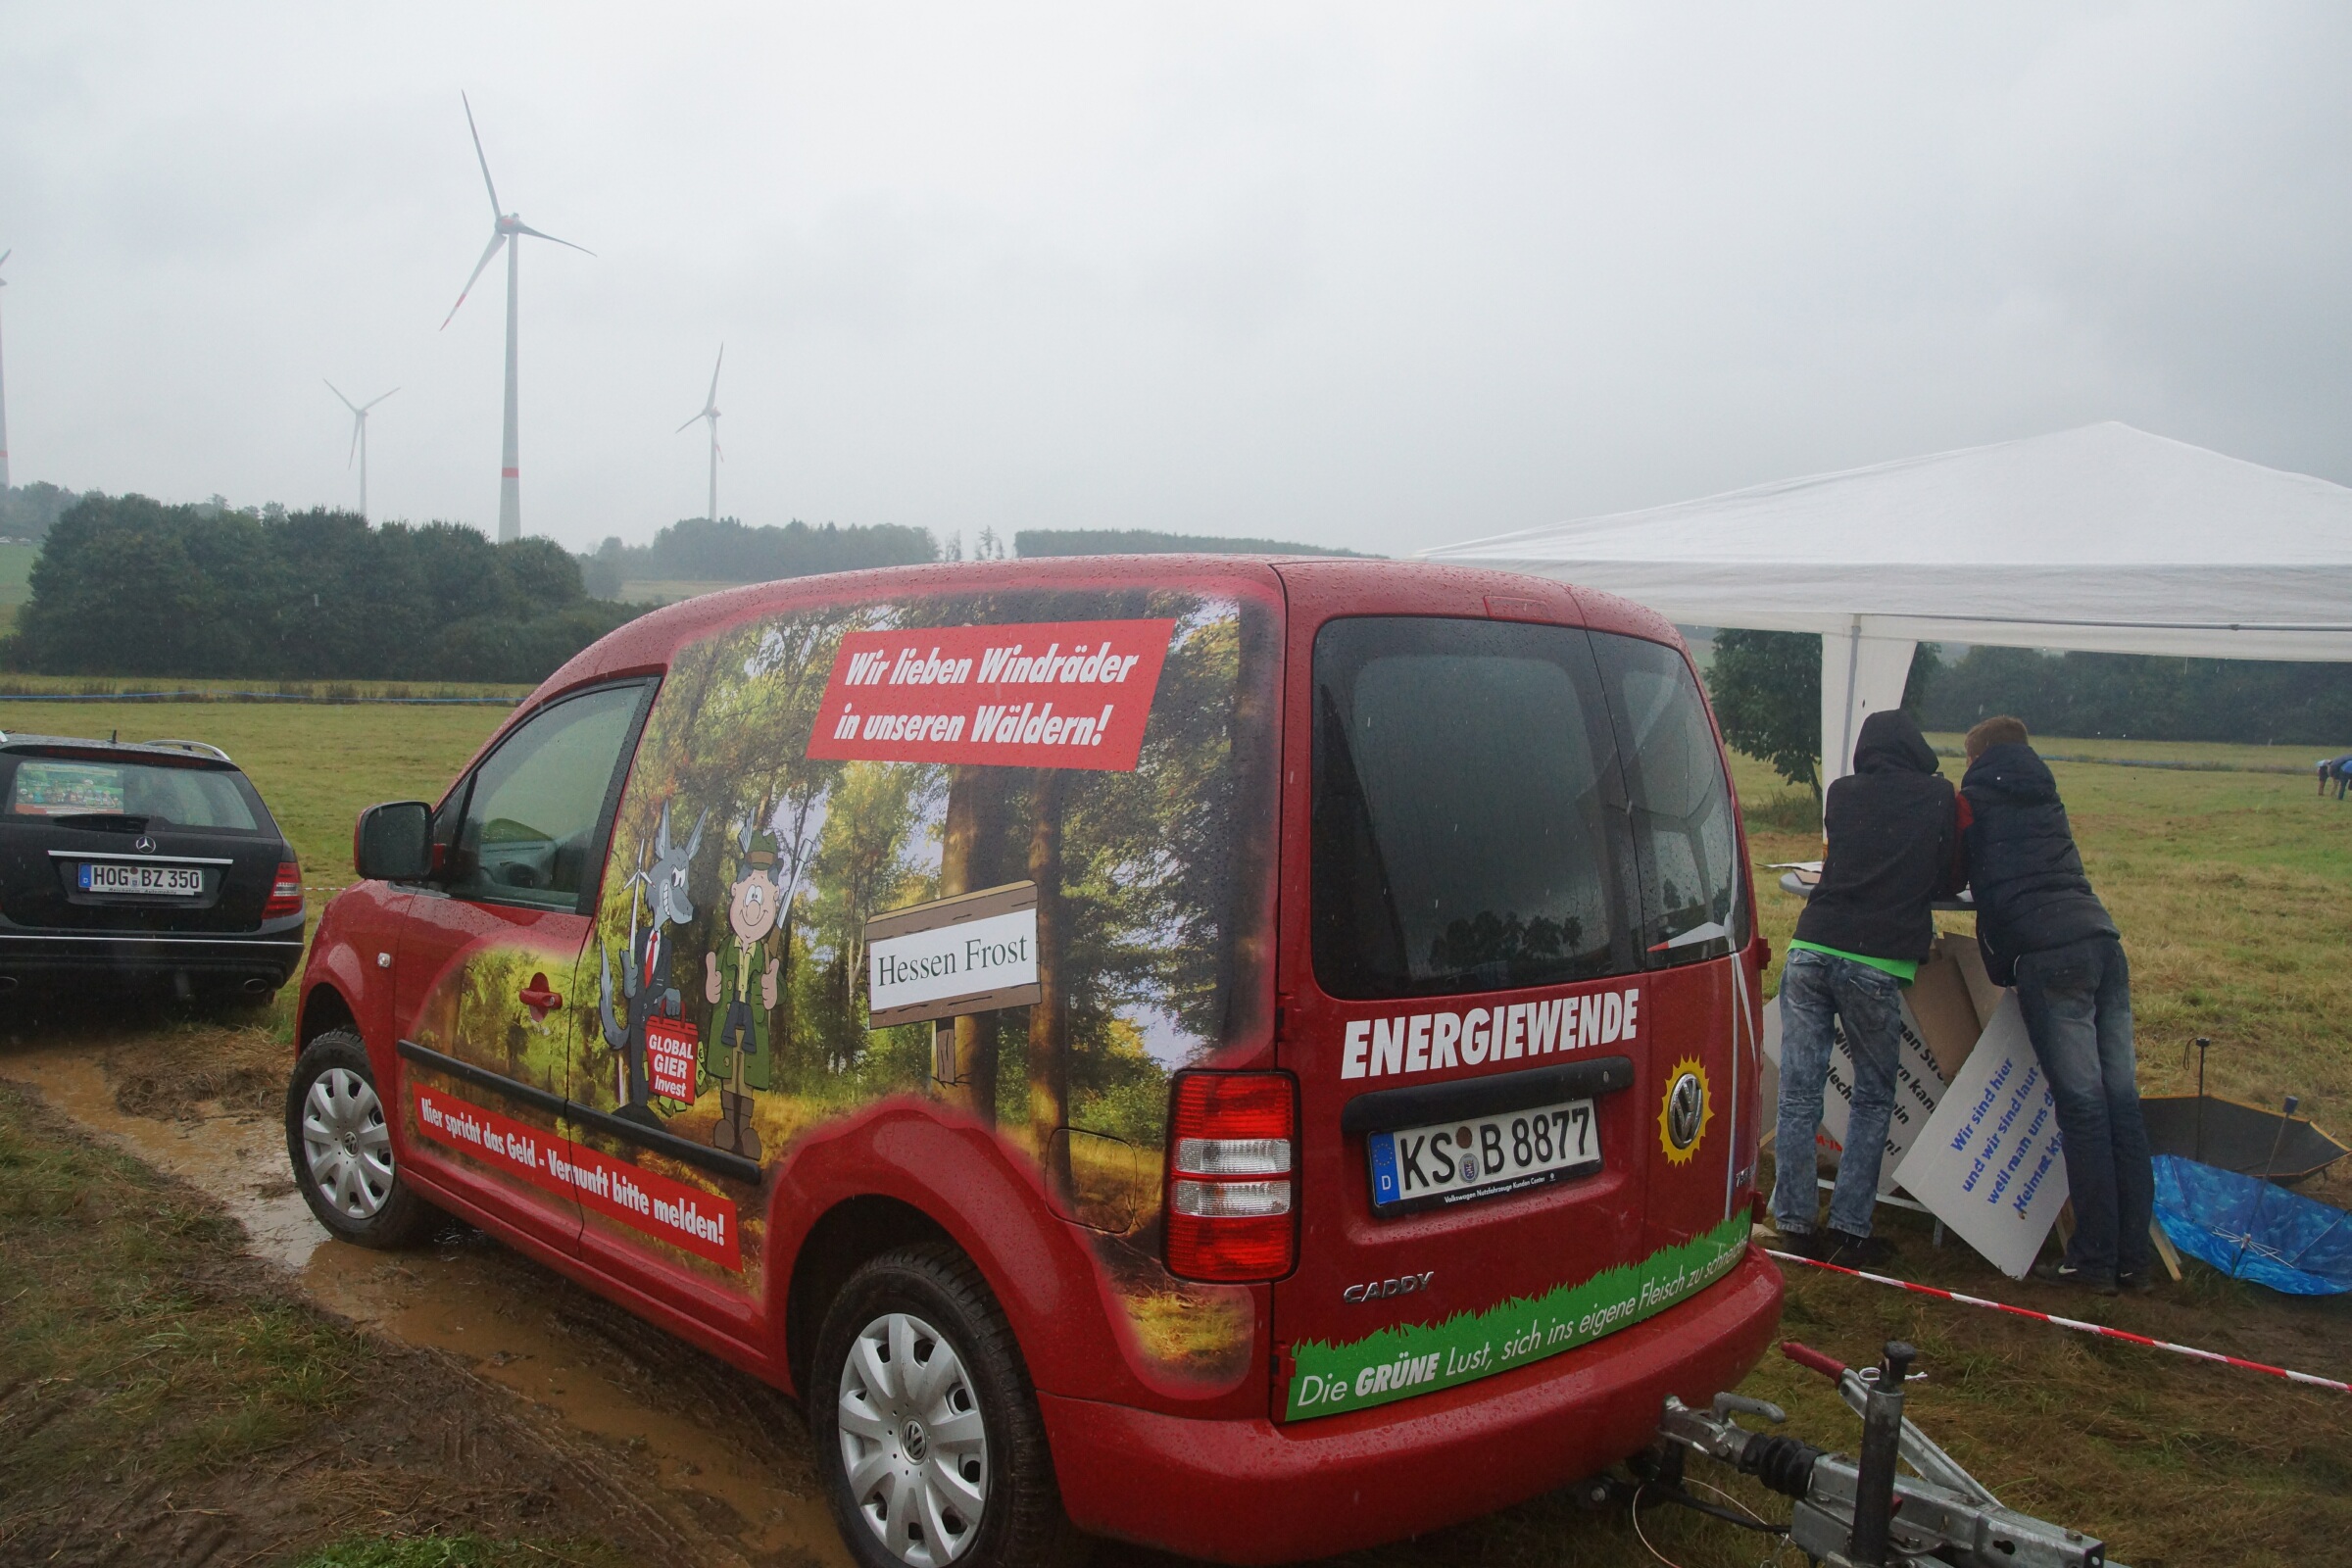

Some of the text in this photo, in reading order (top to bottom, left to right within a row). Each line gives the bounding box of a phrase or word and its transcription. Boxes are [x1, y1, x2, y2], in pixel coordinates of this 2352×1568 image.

[845, 642, 1139, 685] Wir lieben Windräder
[834, 703, 1113, 746] in unseren Wäldern!
[94, 867, 199, 889] HOG BZ 350
[878, 935, 1027, 987] Hessen Frost
[649, 1034, 693, 1059] GLOBAL
[1341, 989, 1639, 1079] ENERGIEWENDE
[654, 1054, 688, 1079] GIER
[655, 1075, 686, 1097] Invest
[1950, 1057, 2013, 1152] Wir sind hier
[1400, 1106, 1590, 1191] KS B 8877
[1962, 1157, 1985, 1193] und
[1982, 1133, 2000, 1160] wir
[1998, 1097, 2022, 1134] sind
[2015, 1066, 2039, 1101] laut
[1986, 1087, 2056, 1204] weil man uns d
[421, 1098, 442, 1128] Hier
[445, 1112, 481, 1145] spricht
[484, 1122, 505, 1154] das
[507, 1133, 536, 1168] Geld
[547, 1149, 609, 1198] Vernunft
[612, 1172, 649, 1215] bitte
[654, 1198, 725, 1247] melden!
[1382, 1175, 1392, 1191] D
[1444, 1176, 1545, 1203] Volkswagen Nutzfahrzeuge Kunden Center
[2013, 1154, 2053, 1212] Heimat
[1344, 1271, 1434, 1303] CADDY
[1298, 1372, 1348, 1407] Die
[1354, 1351, 1441, 1396] GRÜNE
[1446, 1342, 1493, 1376] Lust,
[1501, 1319, 1542, 1360] sich
[1547, 1317, 1574, 1346] ins
[1579, 1297, 1636, 1337] eigene
[1638, 1264, 1686, 1311] Fleisch
[1687, 1265, 1705, 1289] zu
